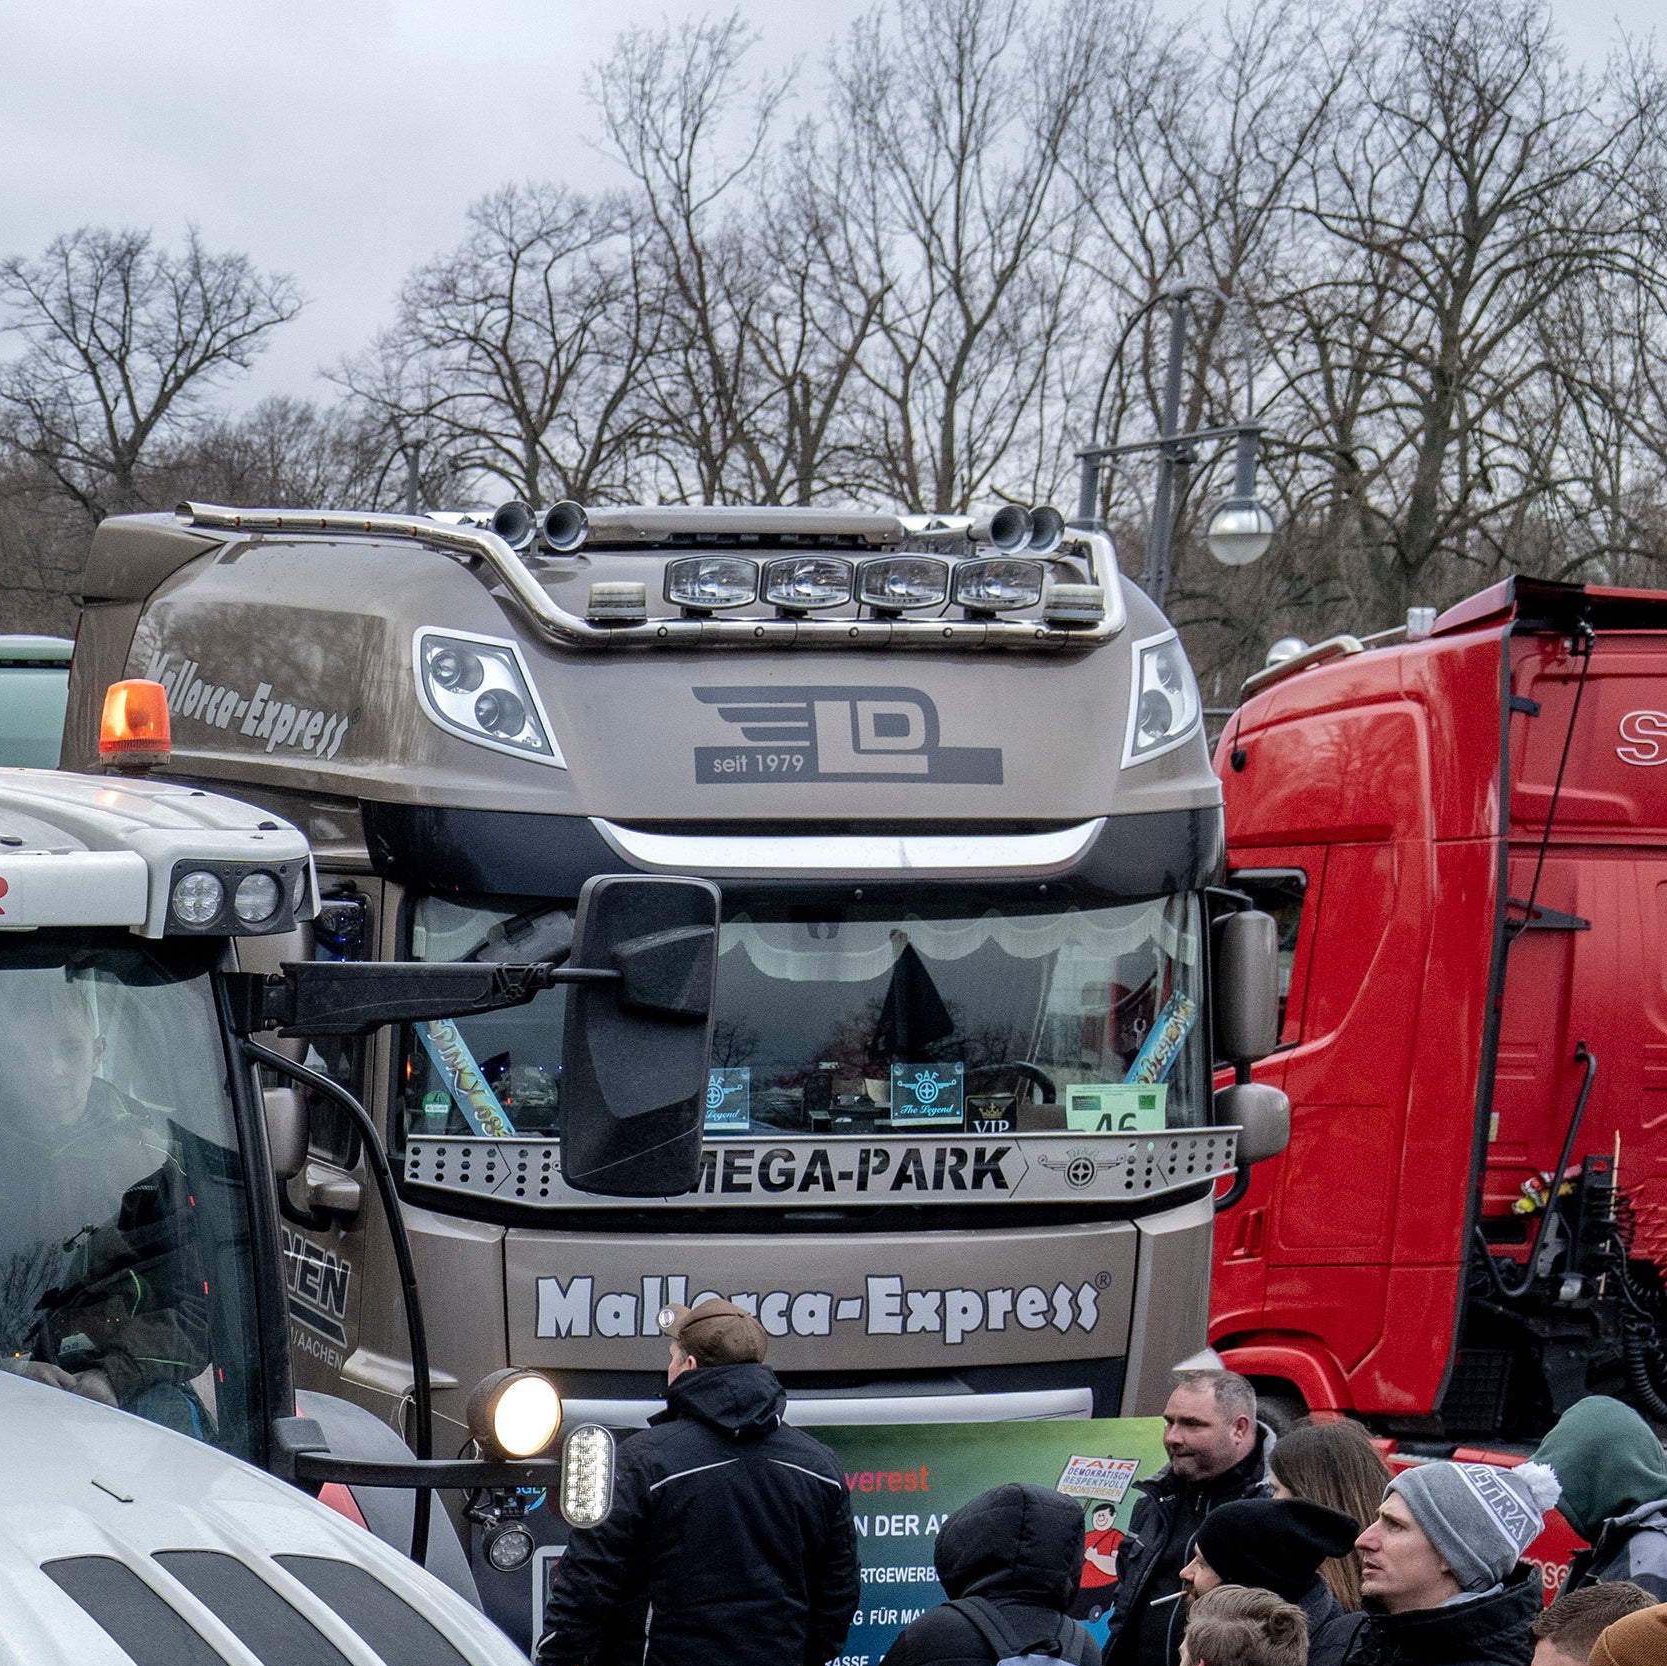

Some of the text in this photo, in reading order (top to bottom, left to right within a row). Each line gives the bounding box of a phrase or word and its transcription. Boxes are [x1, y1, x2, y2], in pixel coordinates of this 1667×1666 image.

[713, 754, 805, 773] seit 1979
[709, 1075, 725, 1085] AF
[915, 1070, 939, 1081] DAF
[900, 1103, 953, 1117] The Legend
[973, 1120, 1010, 1133] VIP
[1071, 1458, 1136, 1471] FAIR
[1067, 1467, 1130, 1480] DEMOKRATISCH
[1063, 1476, 1126, 1489] RESPEKTVOLL
[1060, 1484, 1122, 1497] DEMONSTRIEREN
[875, 1514, 919, 1537] DER
[925, 1513, 949, 1536] A
[870, 1607, 897, 1625] FÜR
